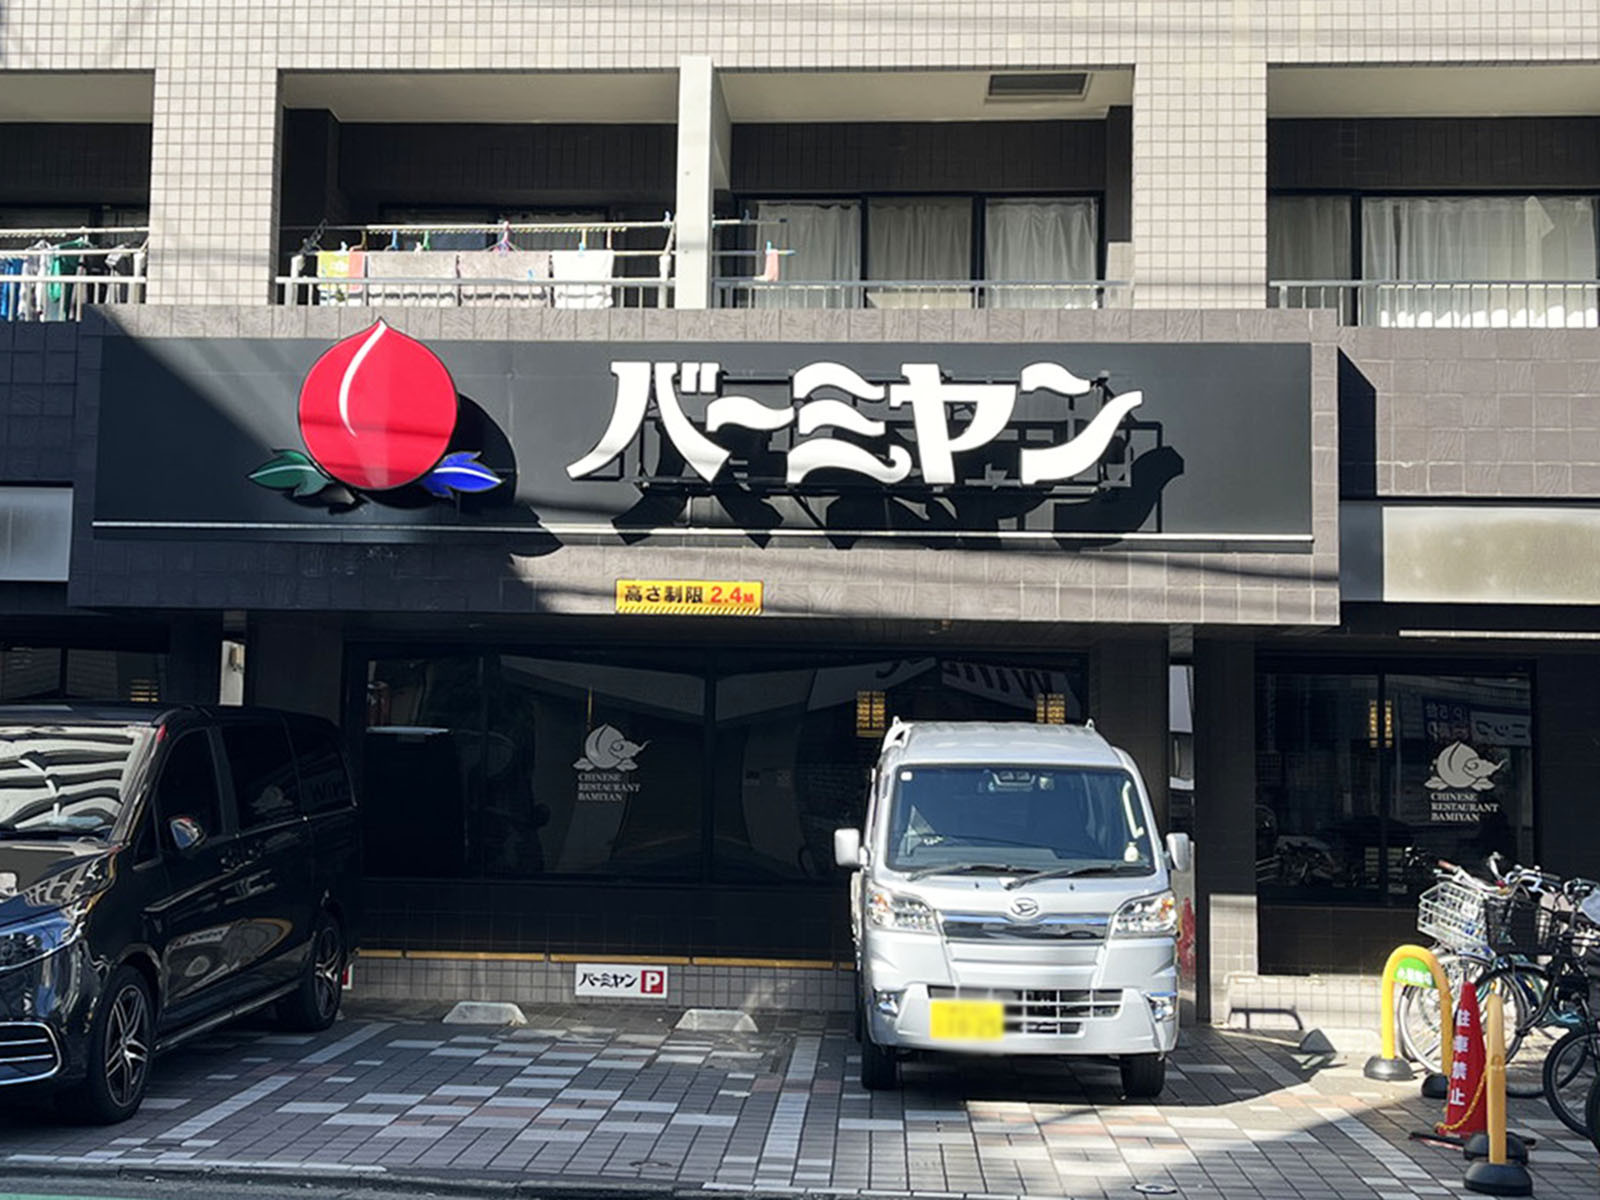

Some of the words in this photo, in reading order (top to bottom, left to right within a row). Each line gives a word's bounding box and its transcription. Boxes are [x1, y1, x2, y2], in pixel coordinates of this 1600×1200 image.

[566, 362, 1143, 485] バーミヤン
[625, 585, 703, 604] 高さ制限
[577, 773, 622, 781] CHINESE
[577, 783, 641, 792] RESTAURANT
[577, 792, 622, 801] BAMIYAN
[1430, 792, 1478, 801] CHINESE
[1430, 802, 1500, 813] RESTAURANT
[1430, 812, 1480, 822] BAMIYAN
[579, 972, 638, 988] バーミヤン
[645, 972, 661, 992] P
[1449, 1009, 1471, 1106] 駐車禁止
